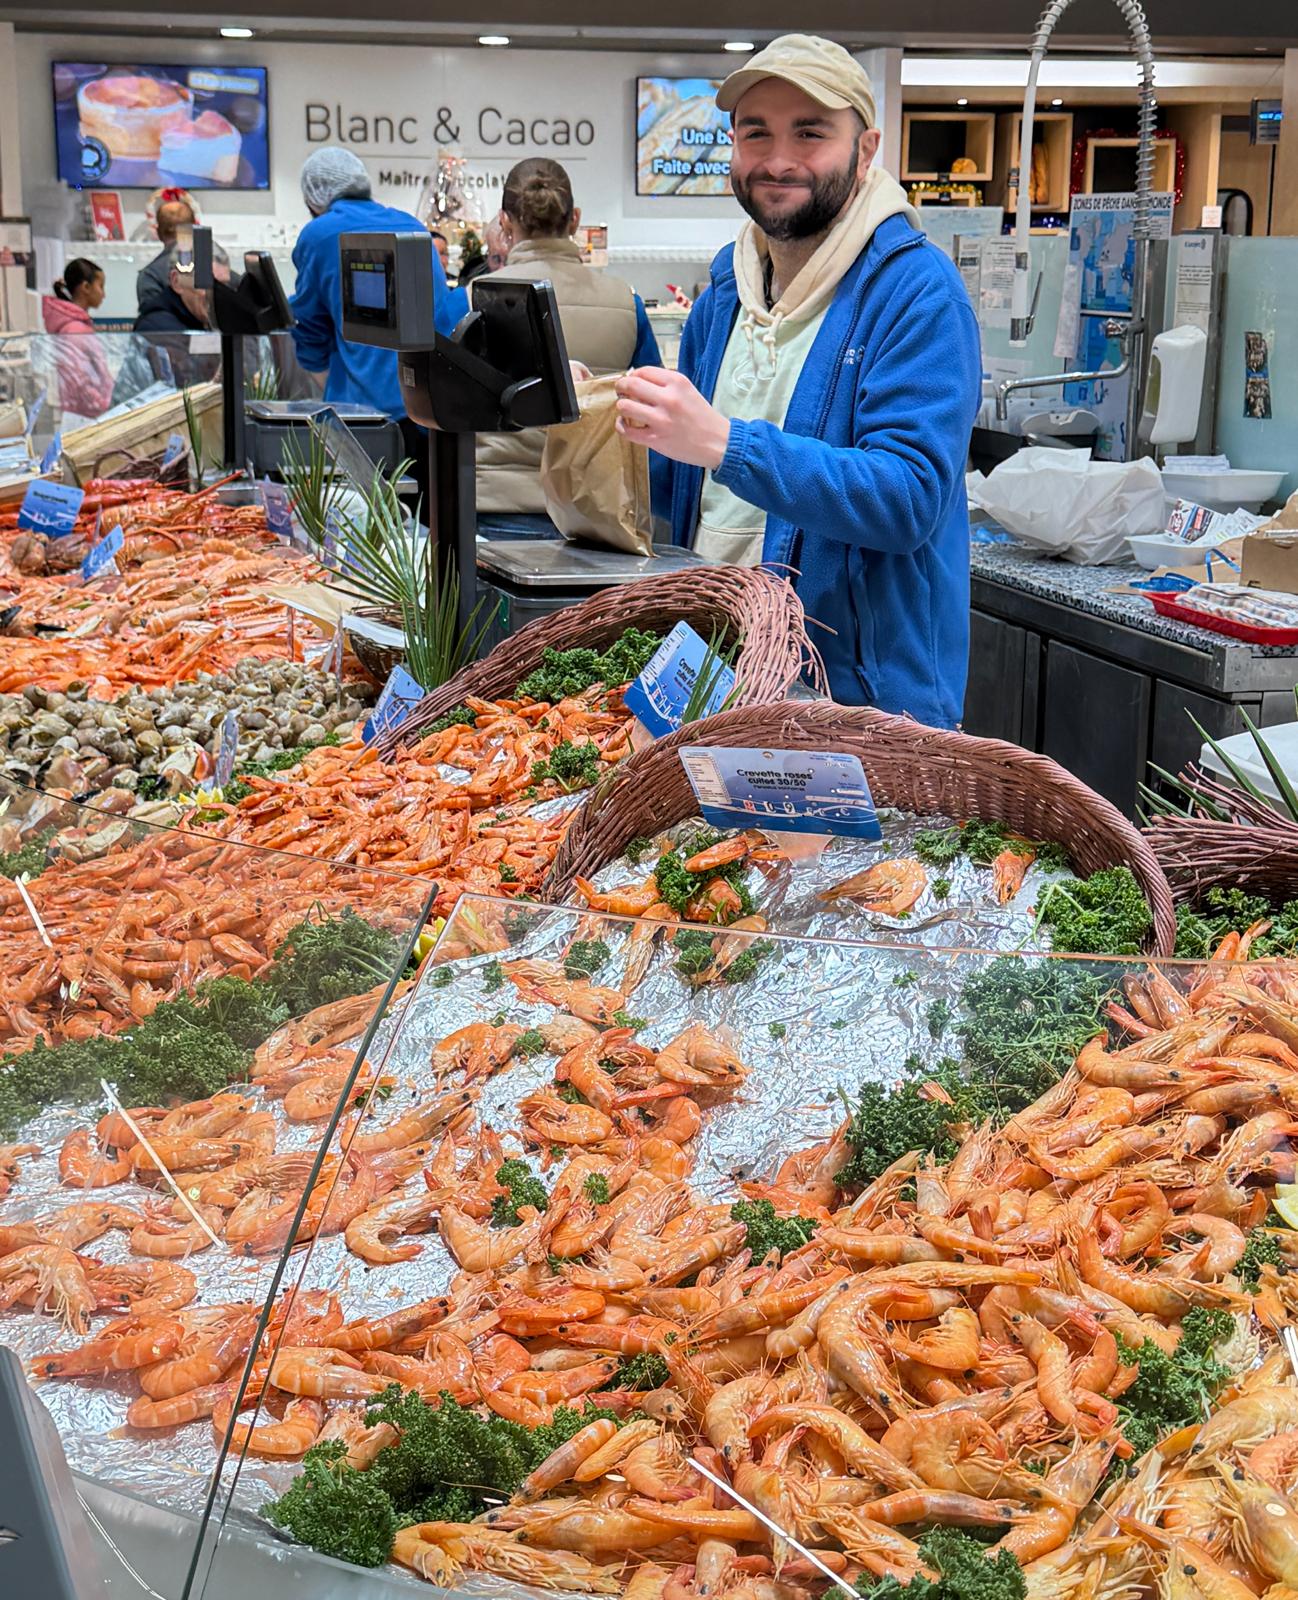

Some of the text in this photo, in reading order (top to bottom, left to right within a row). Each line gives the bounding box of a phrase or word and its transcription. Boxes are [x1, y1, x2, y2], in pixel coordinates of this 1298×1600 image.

[305, 104, 595, 146] Blanc & Cacao
[682, 128, 714, 144] Une
[653, 158, 731, 175] Faite avec
[379, 171, 430, 188] Maître
[1093, 197, 1101, 210] DE
[736, 769, 813, 780] Crevette roses
